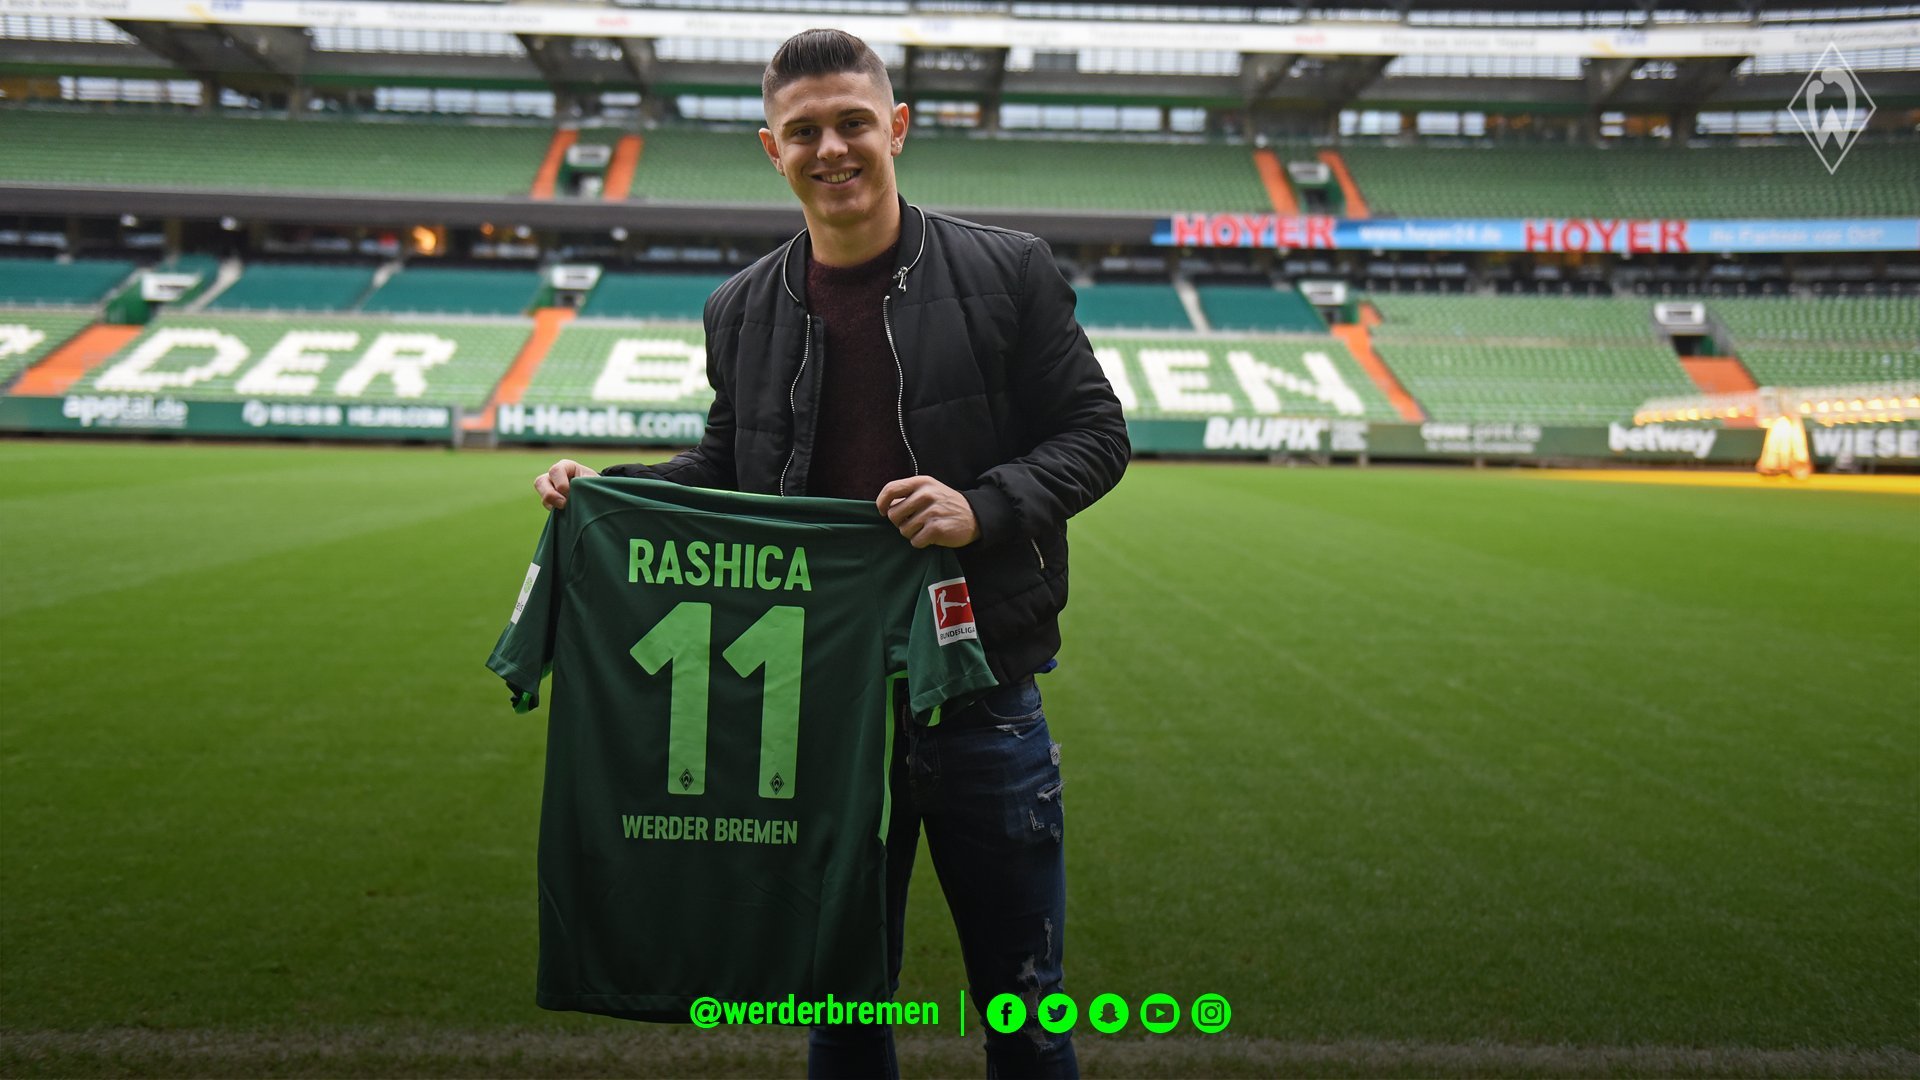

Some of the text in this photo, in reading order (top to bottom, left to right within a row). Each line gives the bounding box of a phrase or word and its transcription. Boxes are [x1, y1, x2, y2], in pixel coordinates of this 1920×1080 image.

[1171, 214, 1338, 248] HOYER
[1522, 218, 1691, 252] HOYER
[63, 395, 189, 427] apotal.de
[501, 404, 704, 438] H-Hotels.com
[1203, 417, 1331, 451] BAUFIX
[1608, 422, 1718, 459] betway
[628, 538, 812, 592] RASHICA
[630, 601, 806, 800] 11
[622, 814, 798, 845] WERDER BREMEN
